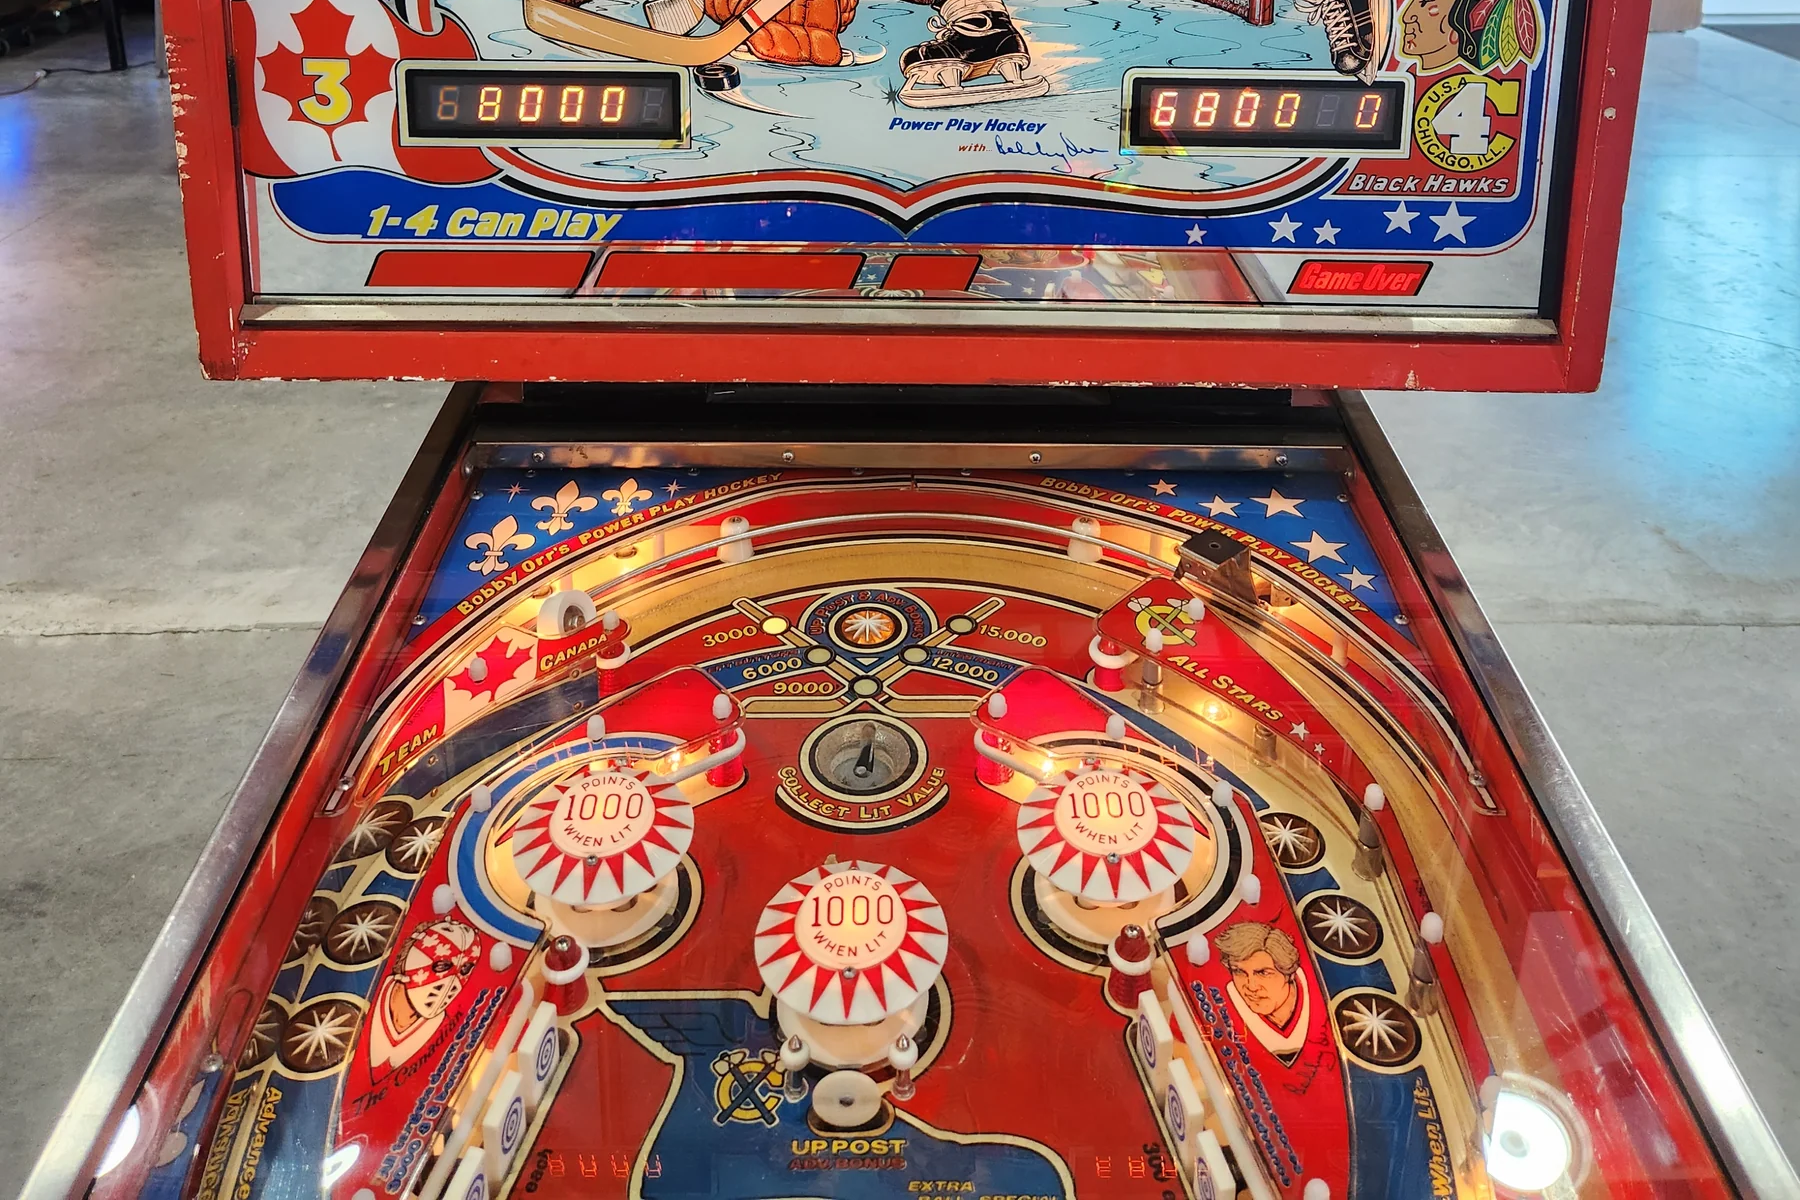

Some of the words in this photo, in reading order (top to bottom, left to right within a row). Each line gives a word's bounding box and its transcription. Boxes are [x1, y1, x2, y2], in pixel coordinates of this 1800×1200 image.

[297, 57, 354, 125] 3
[889, 117, 942, 131] Power
[945, 118, 982, 133] Play
[984, 118, 1047, 134] Hockey
[1431, 82, 1492, 155] 4
[1348, 173, 1419, 194] Black
[1424, 173, 1509, 195] Hawks
[367, 205, 438, 237] 1-4
[445, 208, 527, 238] Can
[529, 210, 623, 241] Play
[648, 492, 698, 518] PLAY
[703, 471, 783, 500] HOCKEY
[1287, 560, 1372, 614] HOCKEY
[701, 625, 758, 648] 3000
[978, 624, 1048, 648] 15,000
[539, 633, 609, 673] CANADA
[742, 656, 802, 680] 6000
[930, 656, 999, 682] 12,000
[773, 681, 834, 695] 9000
[1166, 655, 1210, 679] ALL
[1212, 675, 1284, 721] STARS
[377, 723, 438, 777] TEAM
[582, 774, 637, 792] POINTS
[777, 766, 851, 818] COLLECT
[859, 805, 891, 819] LIT
[897, 766, 945, 807] VALUE
[1076, 774, 1131, 792] POINTS
[565, 792, 644, 821] 1000
[1070, 791, 1146, 820] 1000
[564, 824, 604, 848] WHEN
[609, 824, 634, 845] LIT
[1075, 821, 1119, 846] WHEN
[1124, 821, 1145, 842] LIT
[824, 875, 882, 893] POINTS
[811, 895, 894, 928] 1000
[813, 930, 859, 958] WHEN
[866, 930, 888, 952] LIT
[353, 1087, 389, 1116] The
[394, 1009, 464, 1088] Canadian
[235, 1086, 283, 1200] Advance
[791, 1139, 831, 1155] UP
[832, 1139, 907, 1156] POST
[834, 1157, 907, 1171] BONUS
[1428, 1122, 1453, 1198] When
[908, 1181, 976, 1193] EXTRA
